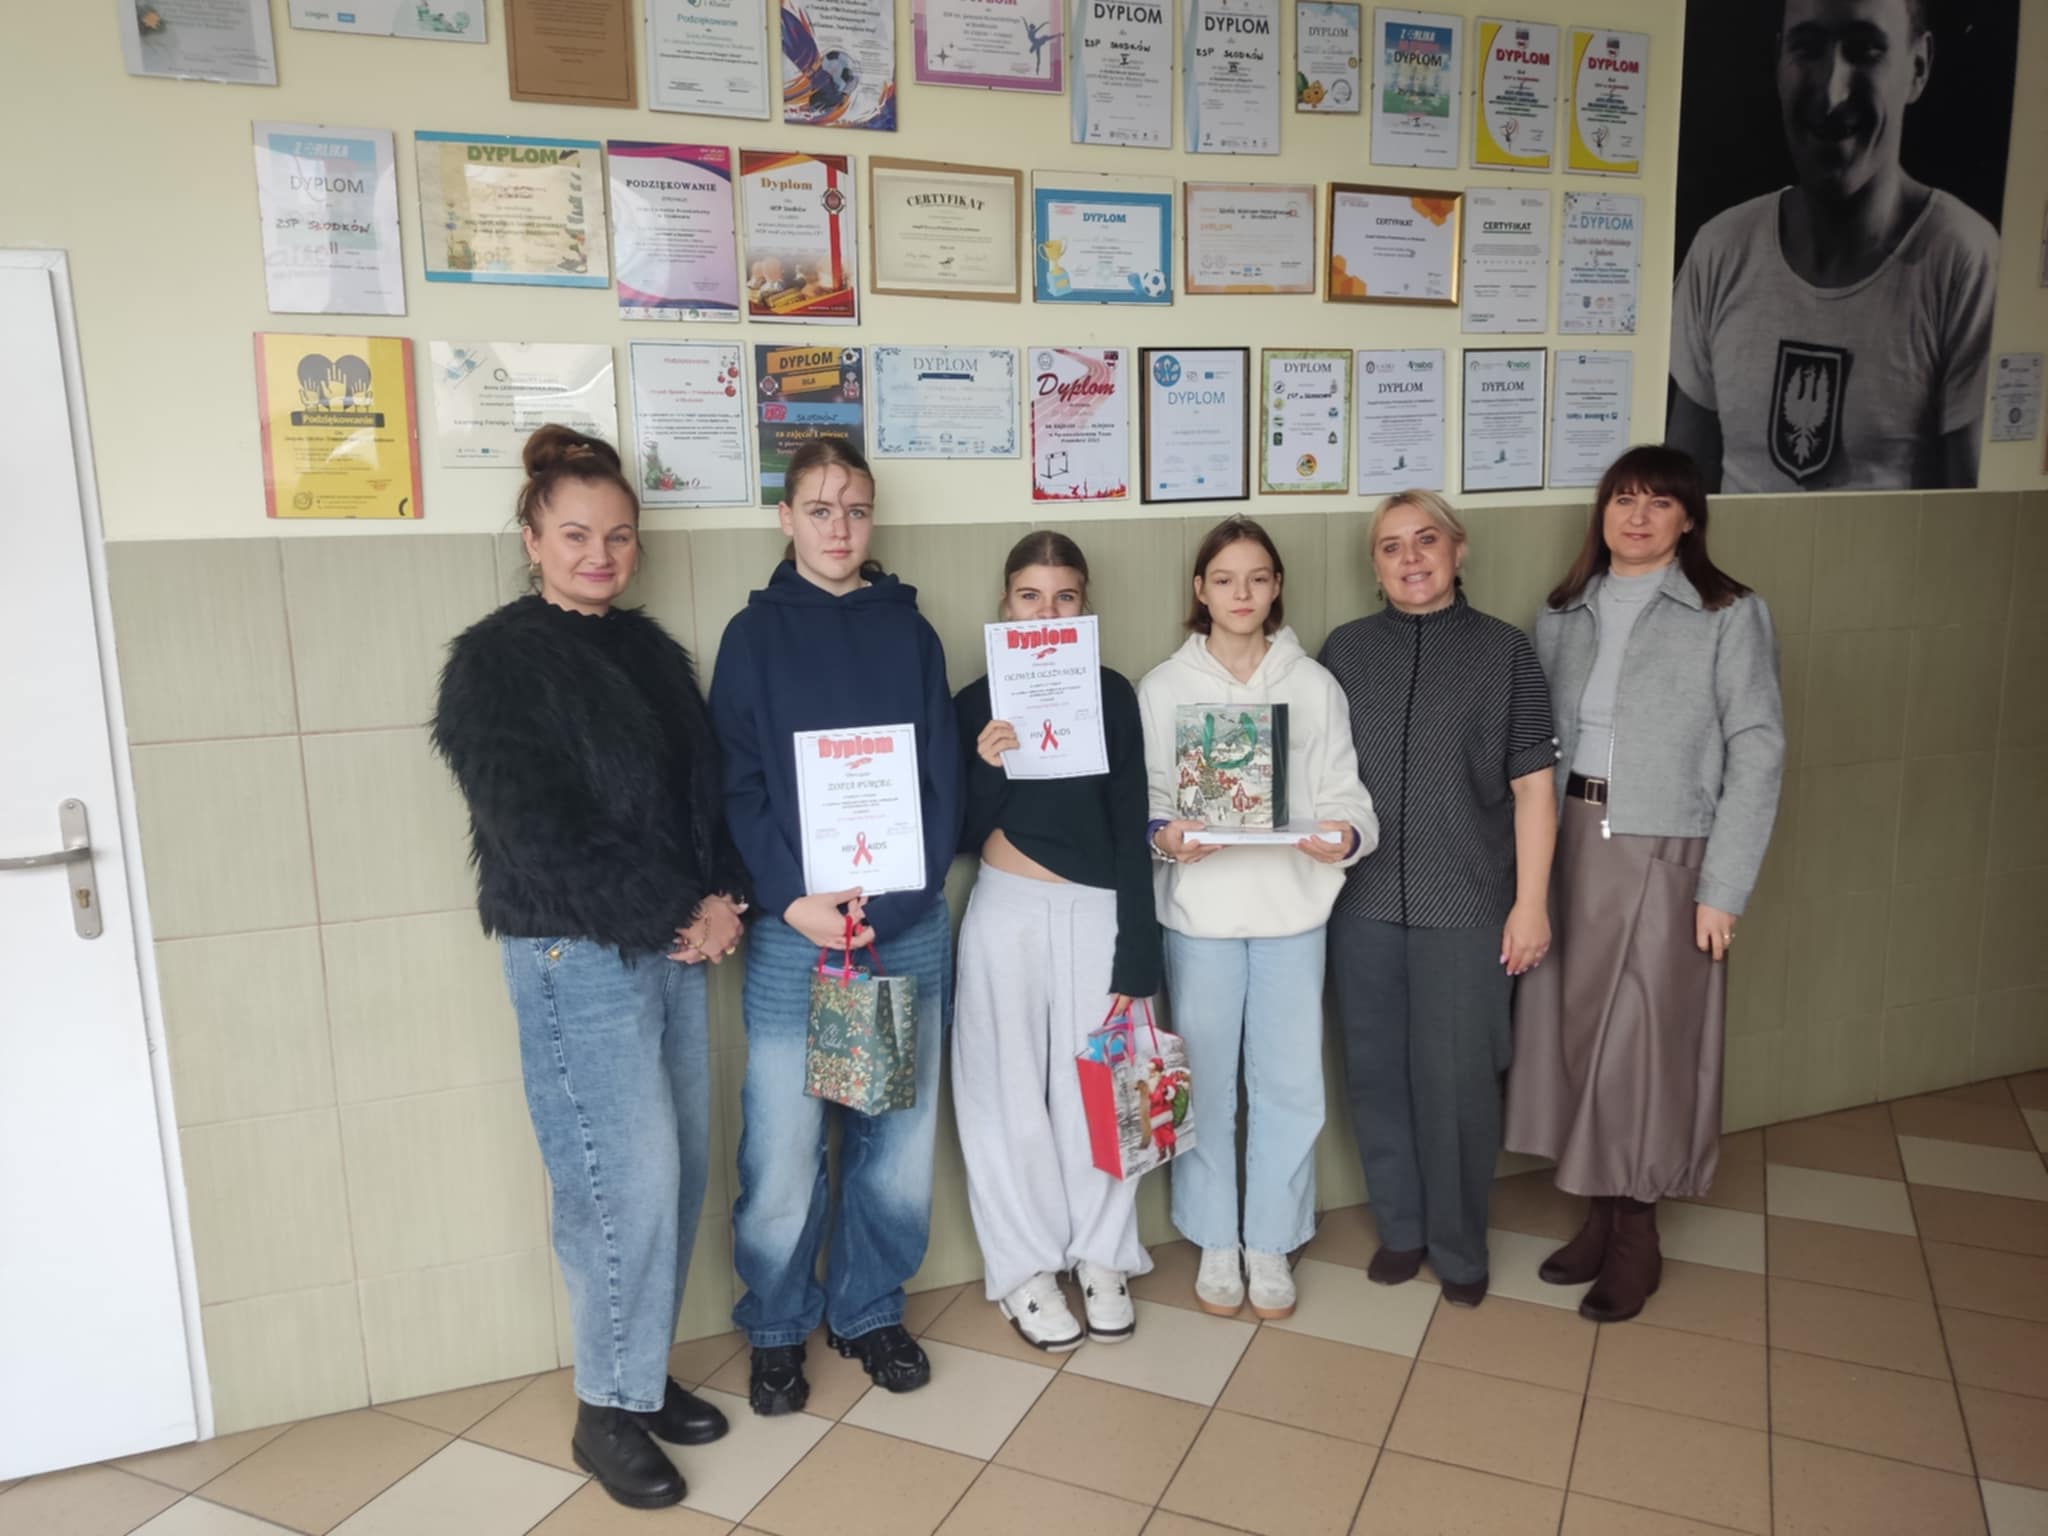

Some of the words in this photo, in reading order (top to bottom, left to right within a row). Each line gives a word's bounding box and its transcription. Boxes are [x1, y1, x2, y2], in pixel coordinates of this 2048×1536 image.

[1094, 3, 1163, 24] DYPLOM
[1204, 15, 1270, 35] DYPLOM
[1308, 26, 1349, 38] DYPLOM
[1393, 51, 1443, 67] DYPLOM
[1495, 48, 1551, 66] DYPLOM
[1587, 57, 1639, 74] DYPLOM
[467, 145, 559, 165] DYPLOM
[289, 175, 364, 194] DYPLOM
[625, 179, 717, 193] PODZIĘKOWANIE
[760, 177, 813, 193] Dyplom
[906, 192, 985, 211] CERTYFIKAT
[1082, 212, 1127, 223] DYPLOM
[1375, 217, 1414, 227] CERTYFIKAT
[1580, 215, 1633, 231] DYPLOM
[1482, 221, 1532, 231] CERTYFIKAT
[779, 351, 833, 370] DYPLOM
[912, 357, 978, 372] DYPLOM
[1283, 362, 1332, 374] DYPLOM
[1037, 373, 1115, 402] Dyplom
[1378, 382, 1424, 394] DYPLOM
[1481, 381, 1525, 392] DYPLOM
[1167, 391, 1226, 405] DYPLOM
[1007, 627, 1078, 650] Dyplom
[817, 735, 894, 759] Dyplom
